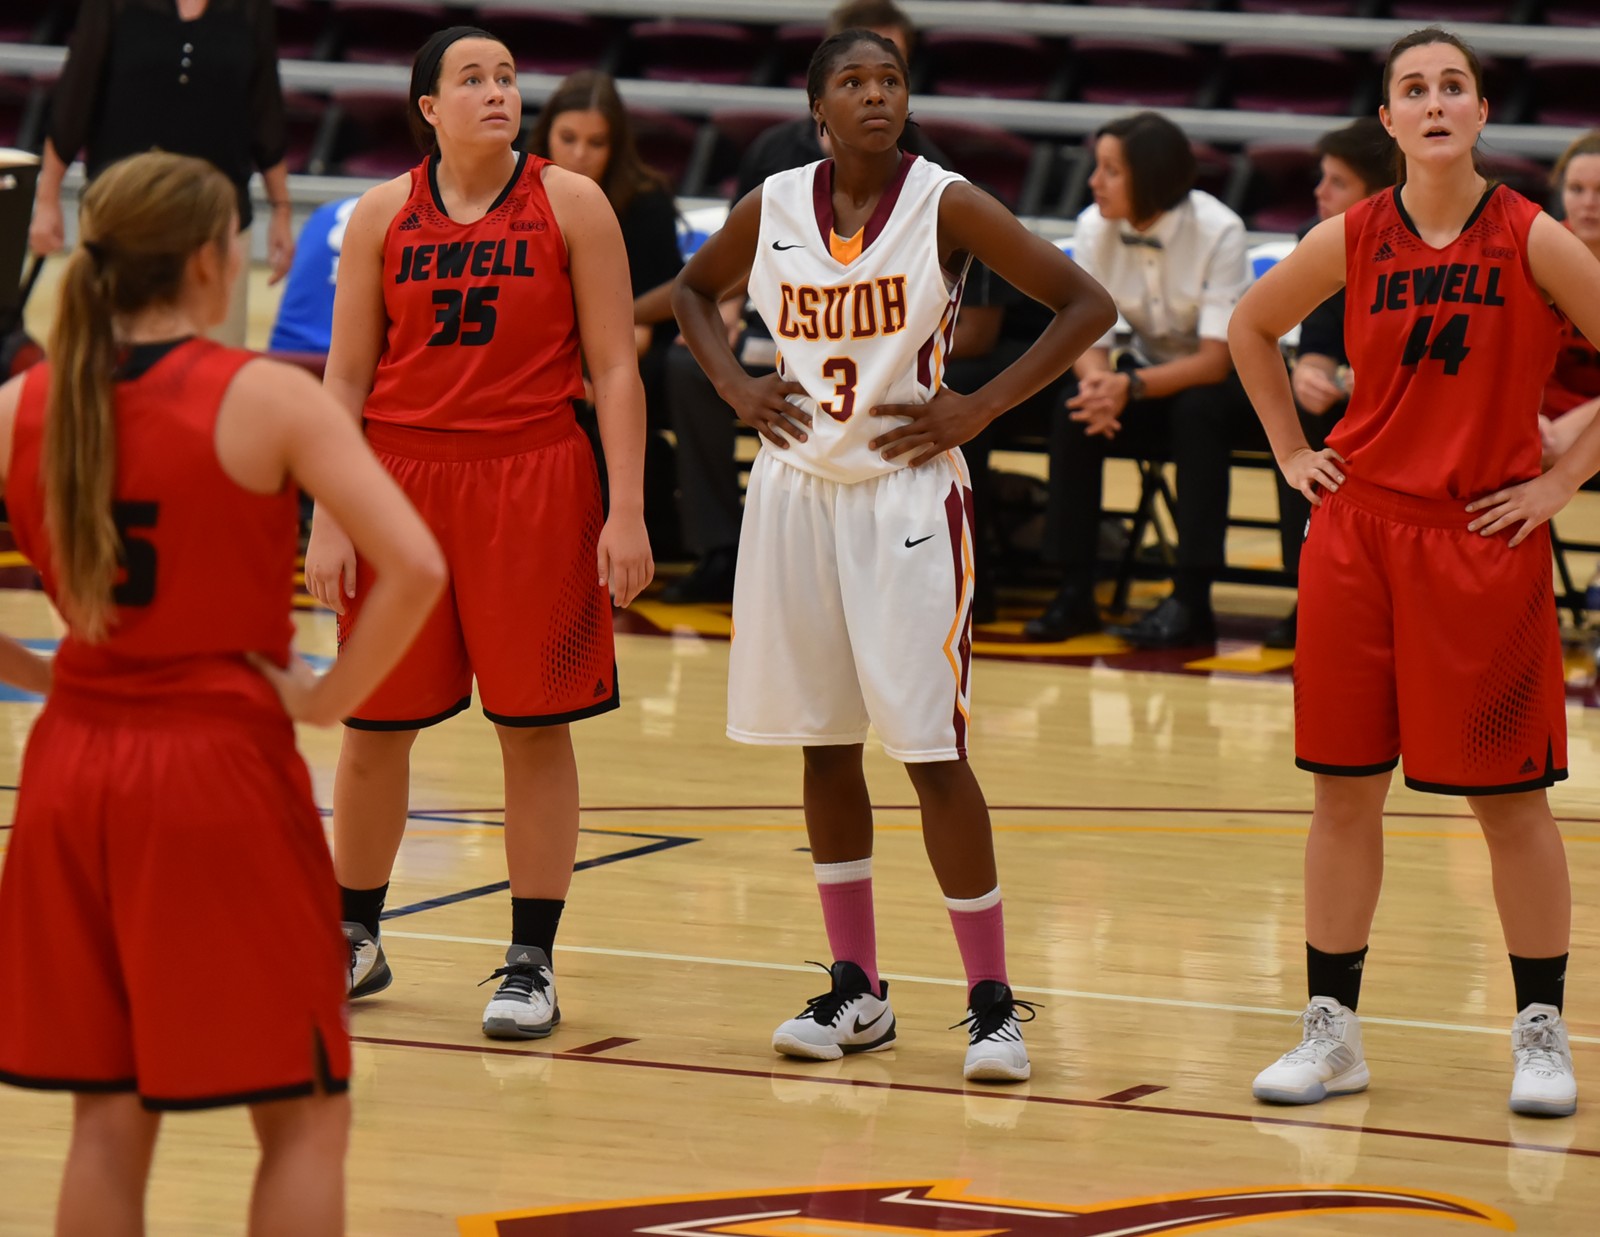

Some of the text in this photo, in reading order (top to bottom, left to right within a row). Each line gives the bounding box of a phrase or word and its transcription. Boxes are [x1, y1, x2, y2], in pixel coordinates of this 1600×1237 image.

[395, 238, 535, 284] JEWELL
[1370, 263, 1505, 315] JEWELL
[426, 286, 500, 346] 35
[777, 274, 907, 341] CSUDH
[1401, 313, 1471, 376] 44
[818, 355, 859, 424] 3
[111, 501, 159, 607] 5
